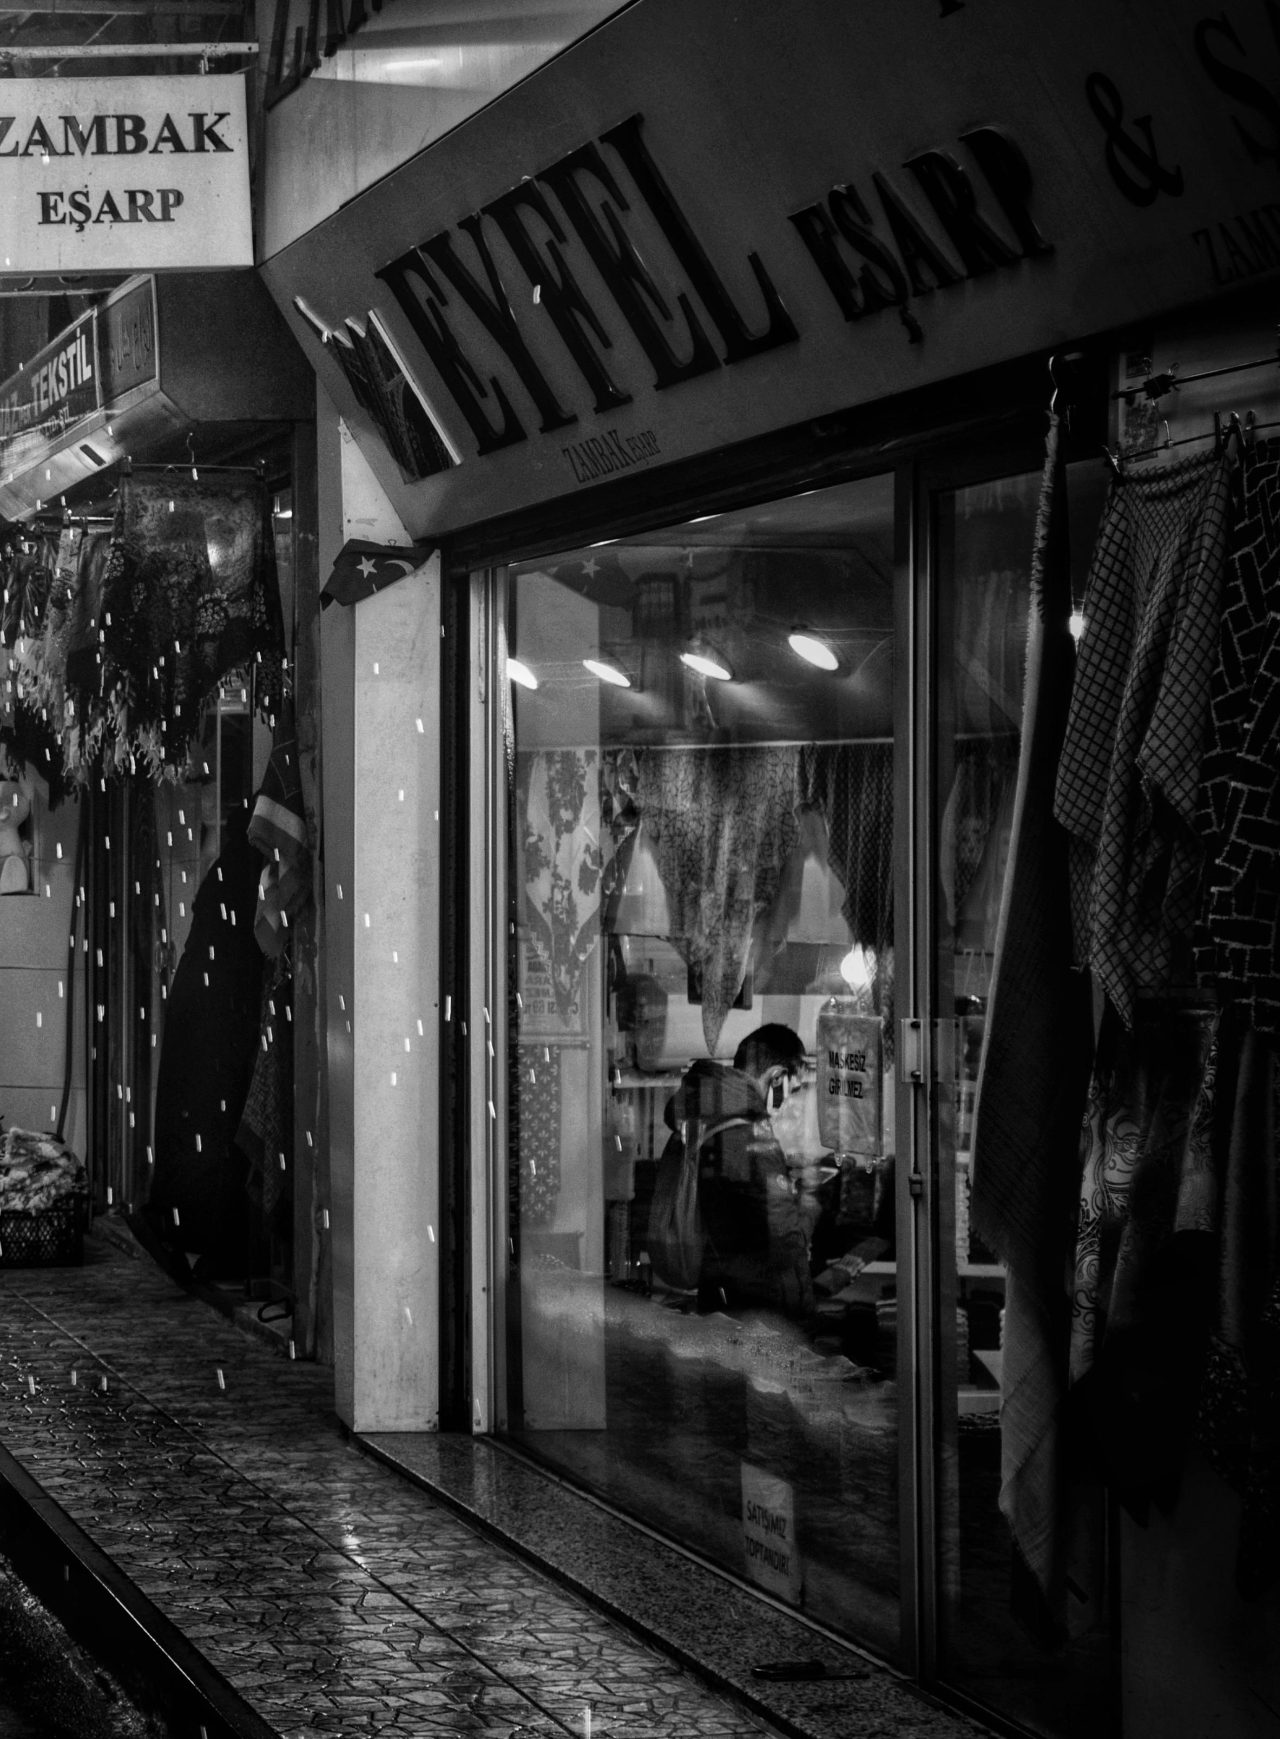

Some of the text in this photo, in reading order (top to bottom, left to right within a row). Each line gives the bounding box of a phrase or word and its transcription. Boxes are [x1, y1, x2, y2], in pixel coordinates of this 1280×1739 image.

[36, 188, 185, 232] EŞARP
[375, 113, 800, 458] EYFEL
[790, 126, 1055, 344] EŞARP
[1085, 71, 1185, 208] &
[31, 326, 92, 416] TEKSTİL
[562, 429, 636, 484] ZAMBAK
